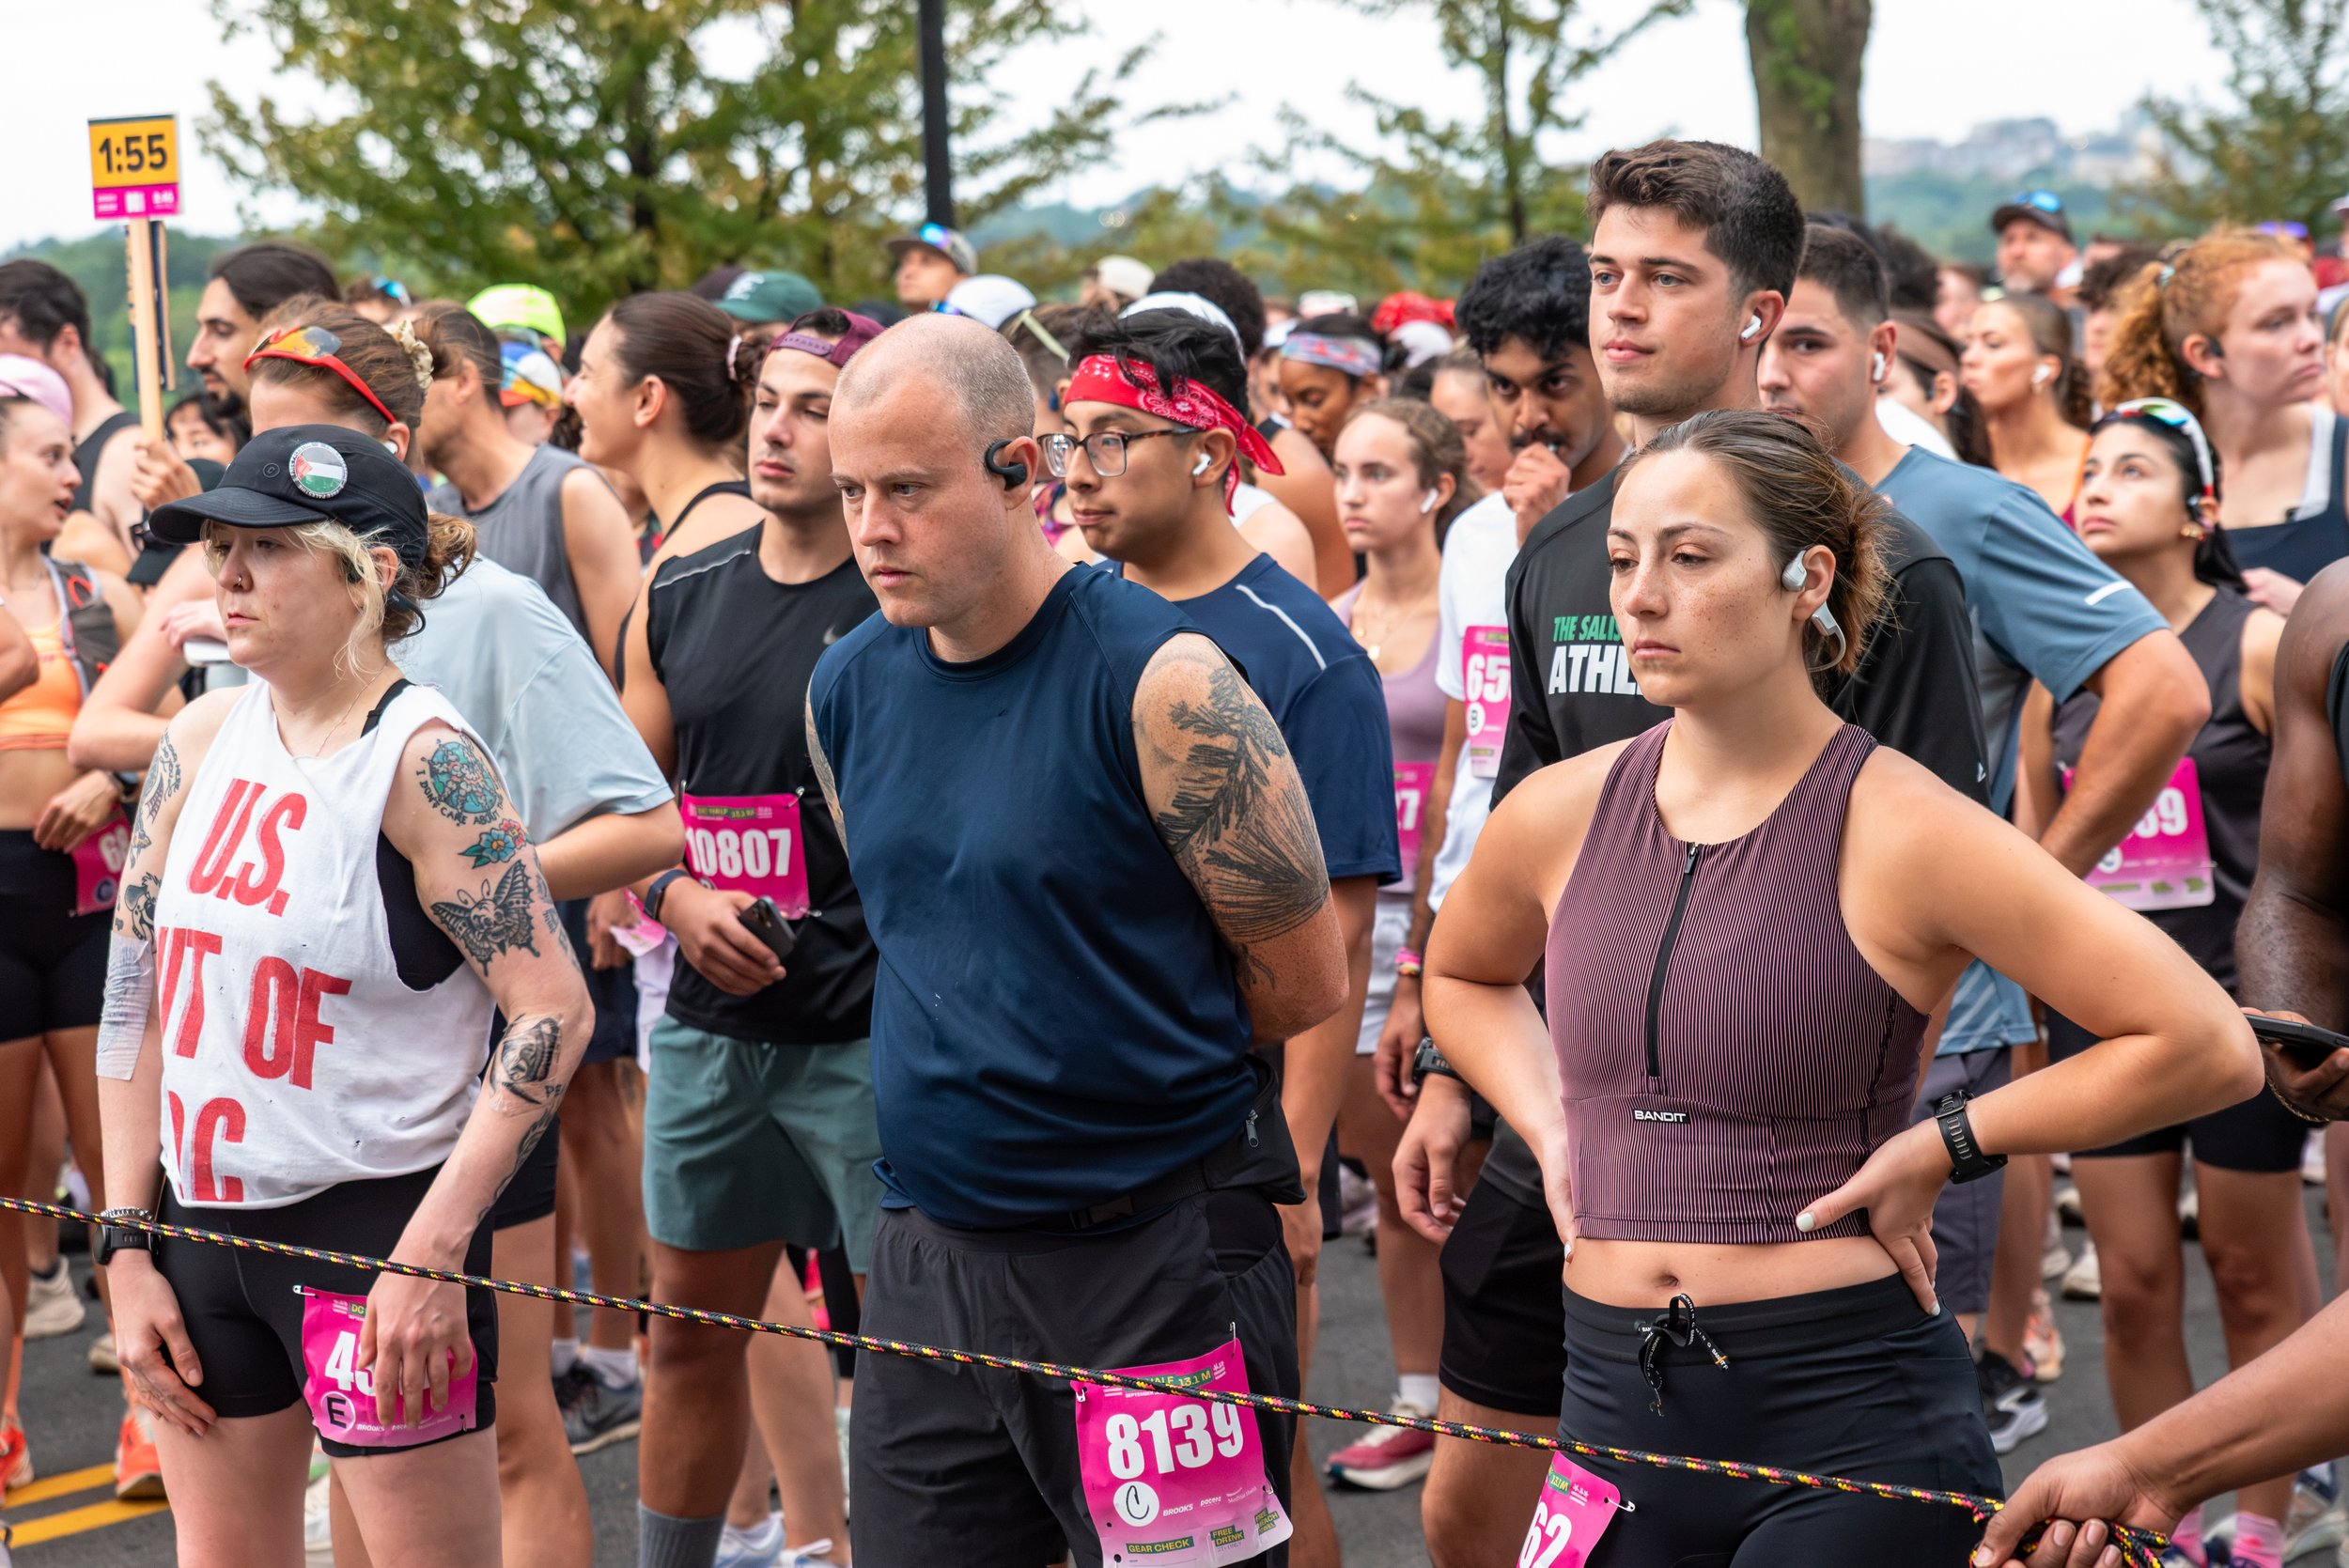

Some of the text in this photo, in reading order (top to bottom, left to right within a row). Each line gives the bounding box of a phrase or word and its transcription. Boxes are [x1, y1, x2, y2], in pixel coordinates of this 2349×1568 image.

[99, 134, 167, 174] 1:55
[1553, 616, 1578, 643] THE
[1467, 654, 1511, 703] 65
[1548, 644, 1643, 695] ATHL
[441, 807, 468, 825] CARE
[186, 778, 307, 917] U.S.
[686, 828, 791, 878] 10807
[241, 955, 352, 1090] OF
[1635, 1110, 1687, 1123] BANDIT
[351, 1303, 365, 1314] DC
[1178, 1374, 1200, 1387] 13.1
[1201, 1371, 1211, 1381] M
[326, 1396, 347, 1429] E
[357, 1423, 385, 1432] BROOKS
[1106, 1402, 1244, 1480] 8139
[1126, 1484, 1150, 1520] C
[1162, 1504, 1193, 1517] BROOKS
[1128, 1539, 1190, 1553] GEAR CHECK
[1212, 1527, 1233, 1539] FREE
[1215, 1531, 1243, 1545] DRINK
